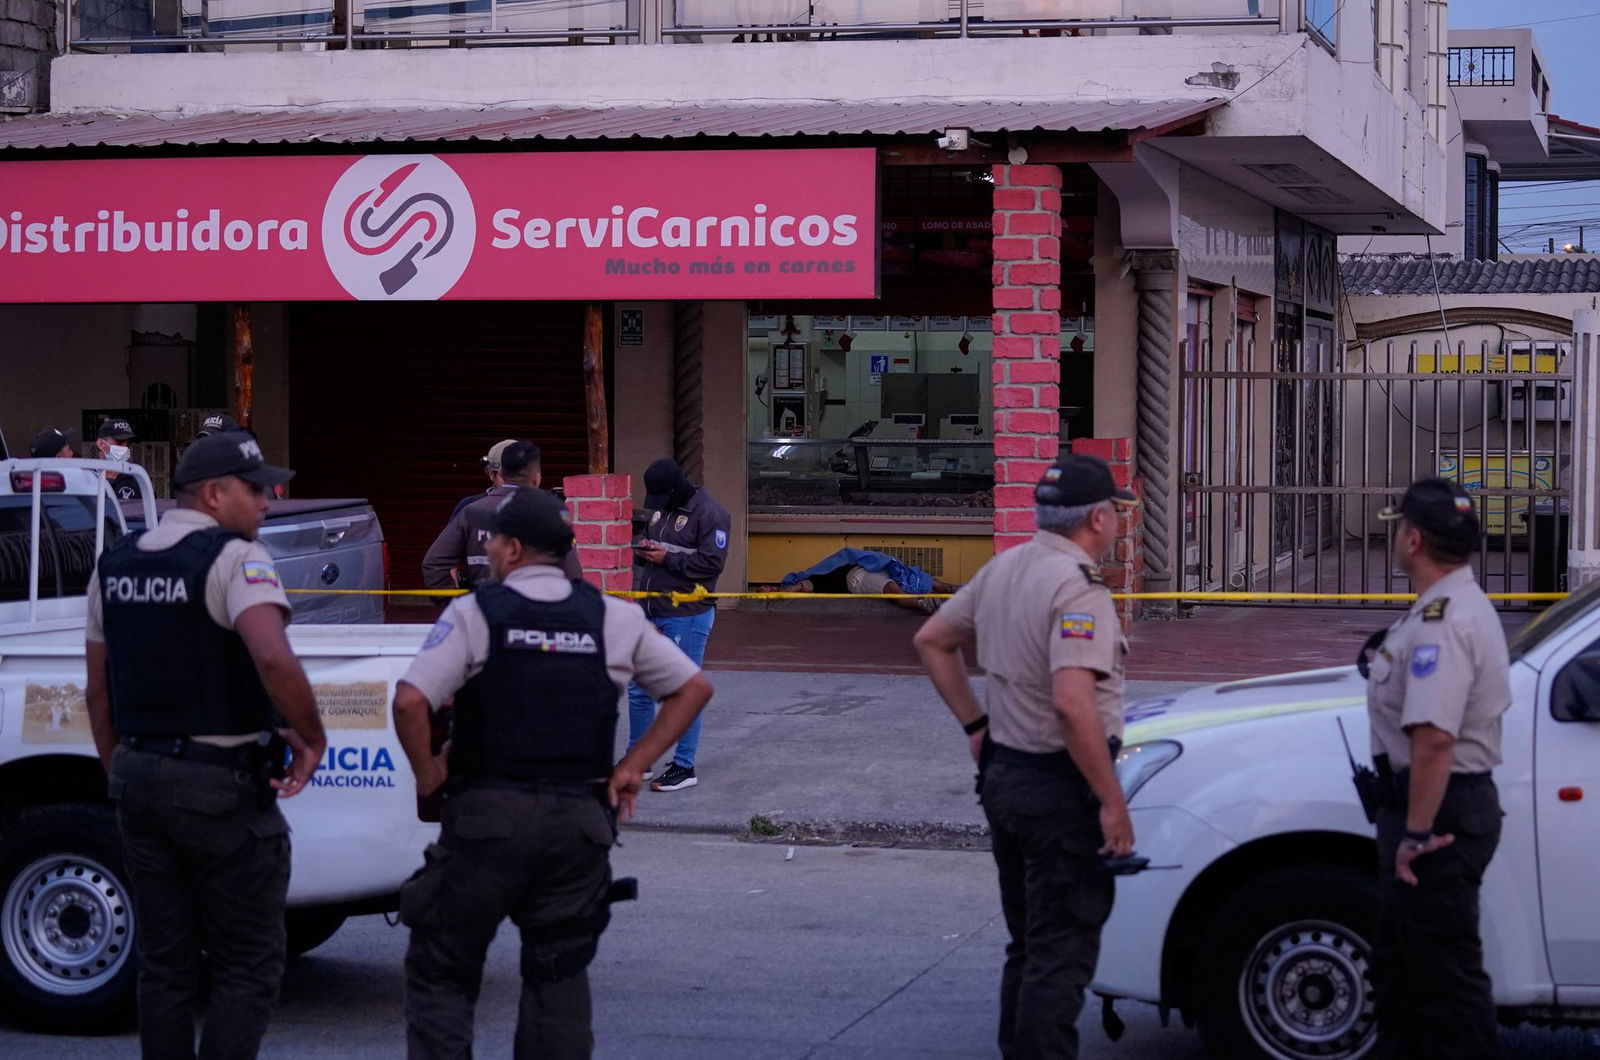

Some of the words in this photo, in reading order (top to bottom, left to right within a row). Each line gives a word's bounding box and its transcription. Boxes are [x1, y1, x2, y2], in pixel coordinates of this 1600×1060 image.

[491, 203, 858, 249] ServiCarnicos
[921, 220, 949, 230] LOMO
[950, 220, 963, 230] DE
[965, 220, 992, 230] ASAD
[605, 258, 681, 276] Mucho
[689, 256, 735, 275] más
[743, 261, 771, 275] en
[778, 259, 856, 275] carnes
[105, 575, 189, 603] POLICIA
[507, 628, 597, 646] POLICIA
[311, 775, 396, 788] NACIONAL
